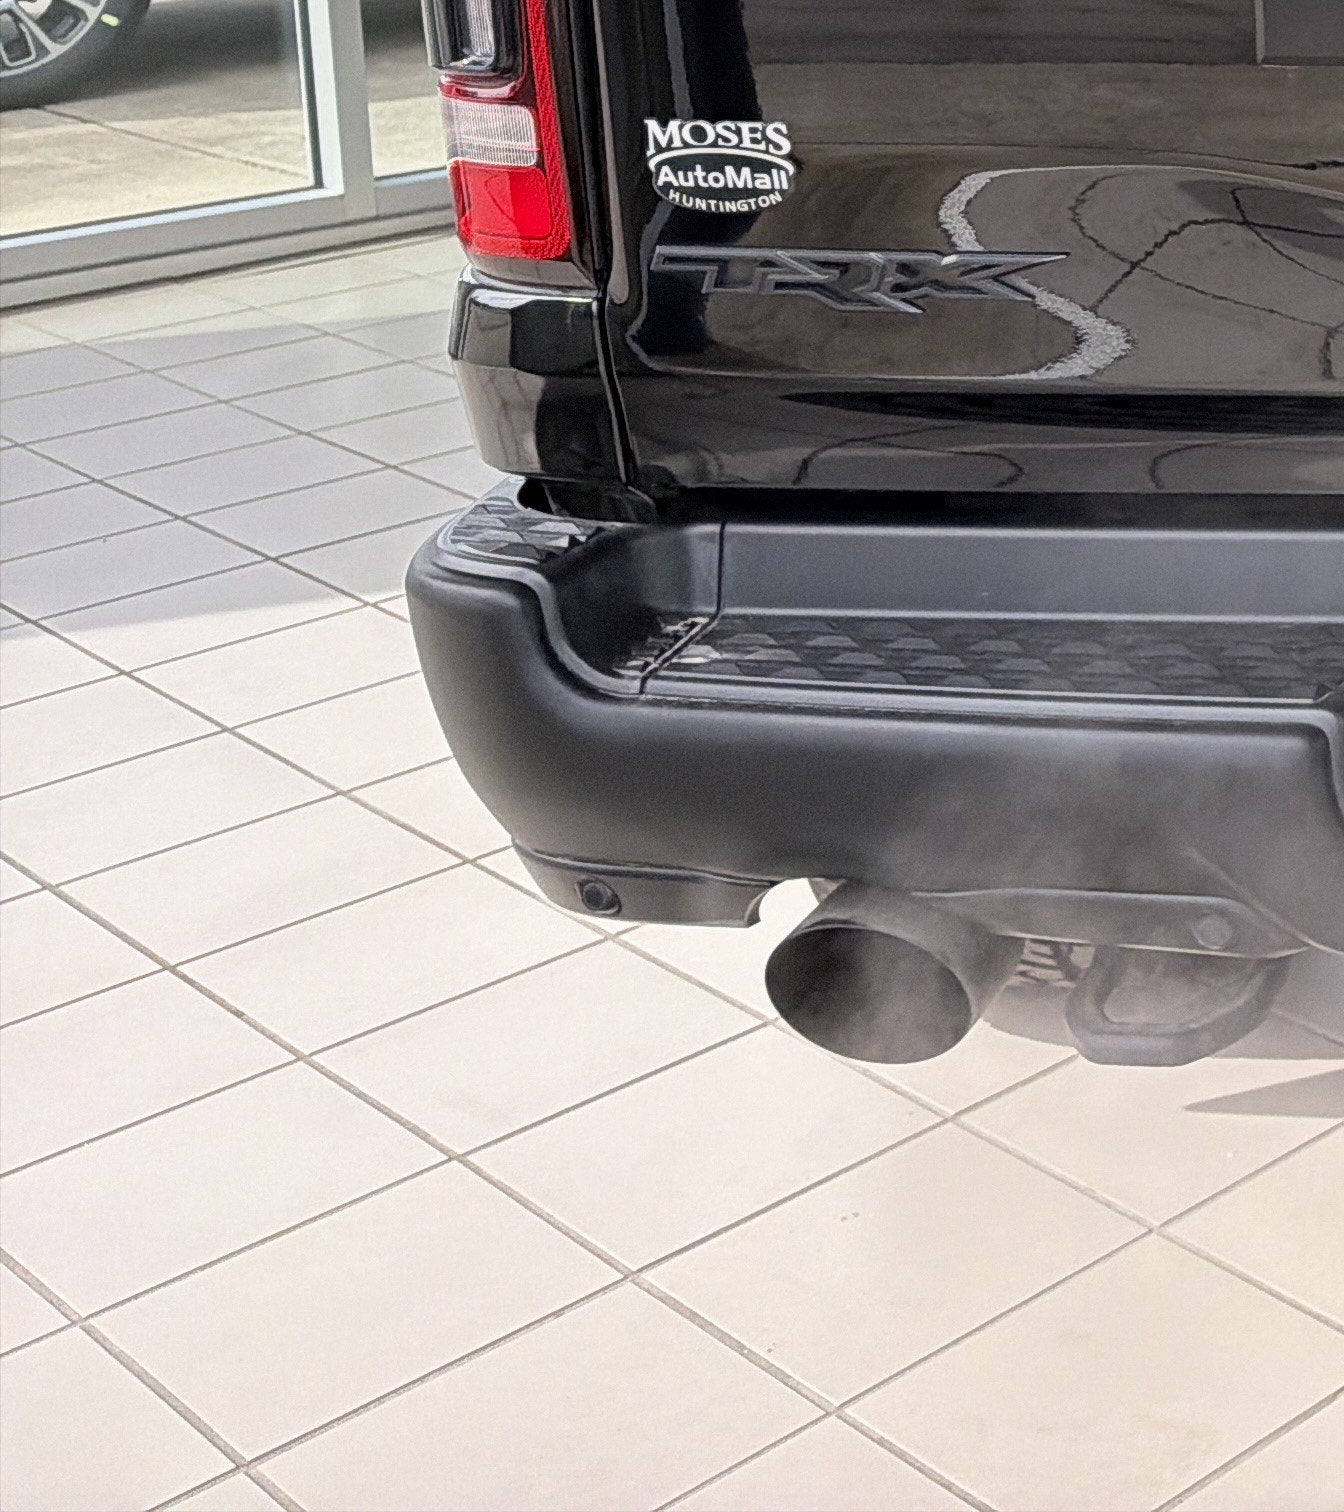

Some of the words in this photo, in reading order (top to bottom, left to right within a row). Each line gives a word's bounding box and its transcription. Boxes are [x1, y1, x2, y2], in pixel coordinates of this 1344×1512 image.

[643, 119, 792, 157] MOSES
[656, 164, 789, 190] AutoMall
[668, 188, 783, 213] HUNTINGTON
[650, 245, 1070, 314] TRX
